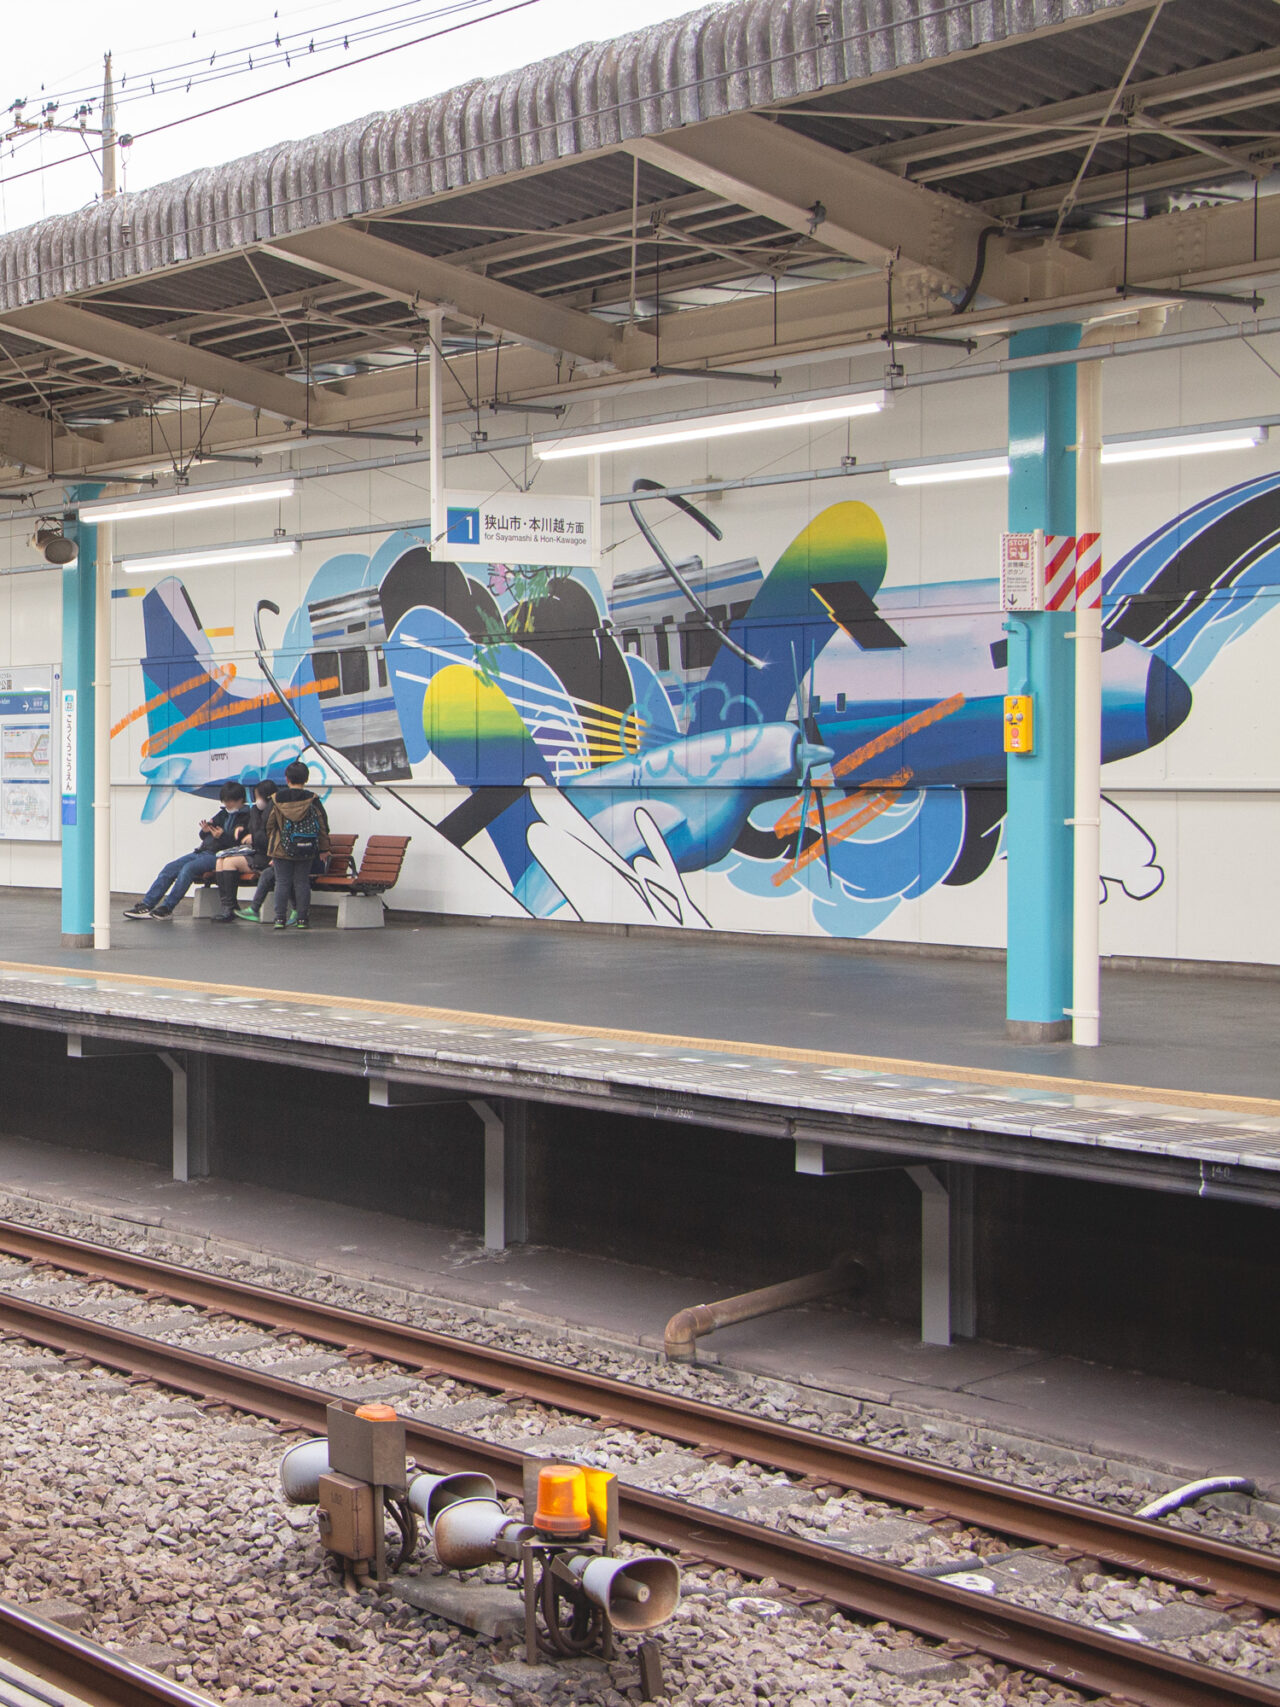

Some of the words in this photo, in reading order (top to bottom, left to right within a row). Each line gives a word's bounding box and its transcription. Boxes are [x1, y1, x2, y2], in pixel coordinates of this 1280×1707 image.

[466, 516, 473, 540] 1
[485, 514, 585, 534] 狭山市・本川越方面
[485, 533, 494, 541] for
[495, 533, 533, 543] Sayamashi
[533, 535, 539, 543] &
[540, 535, 587, 546] Hon-Kawagoe
